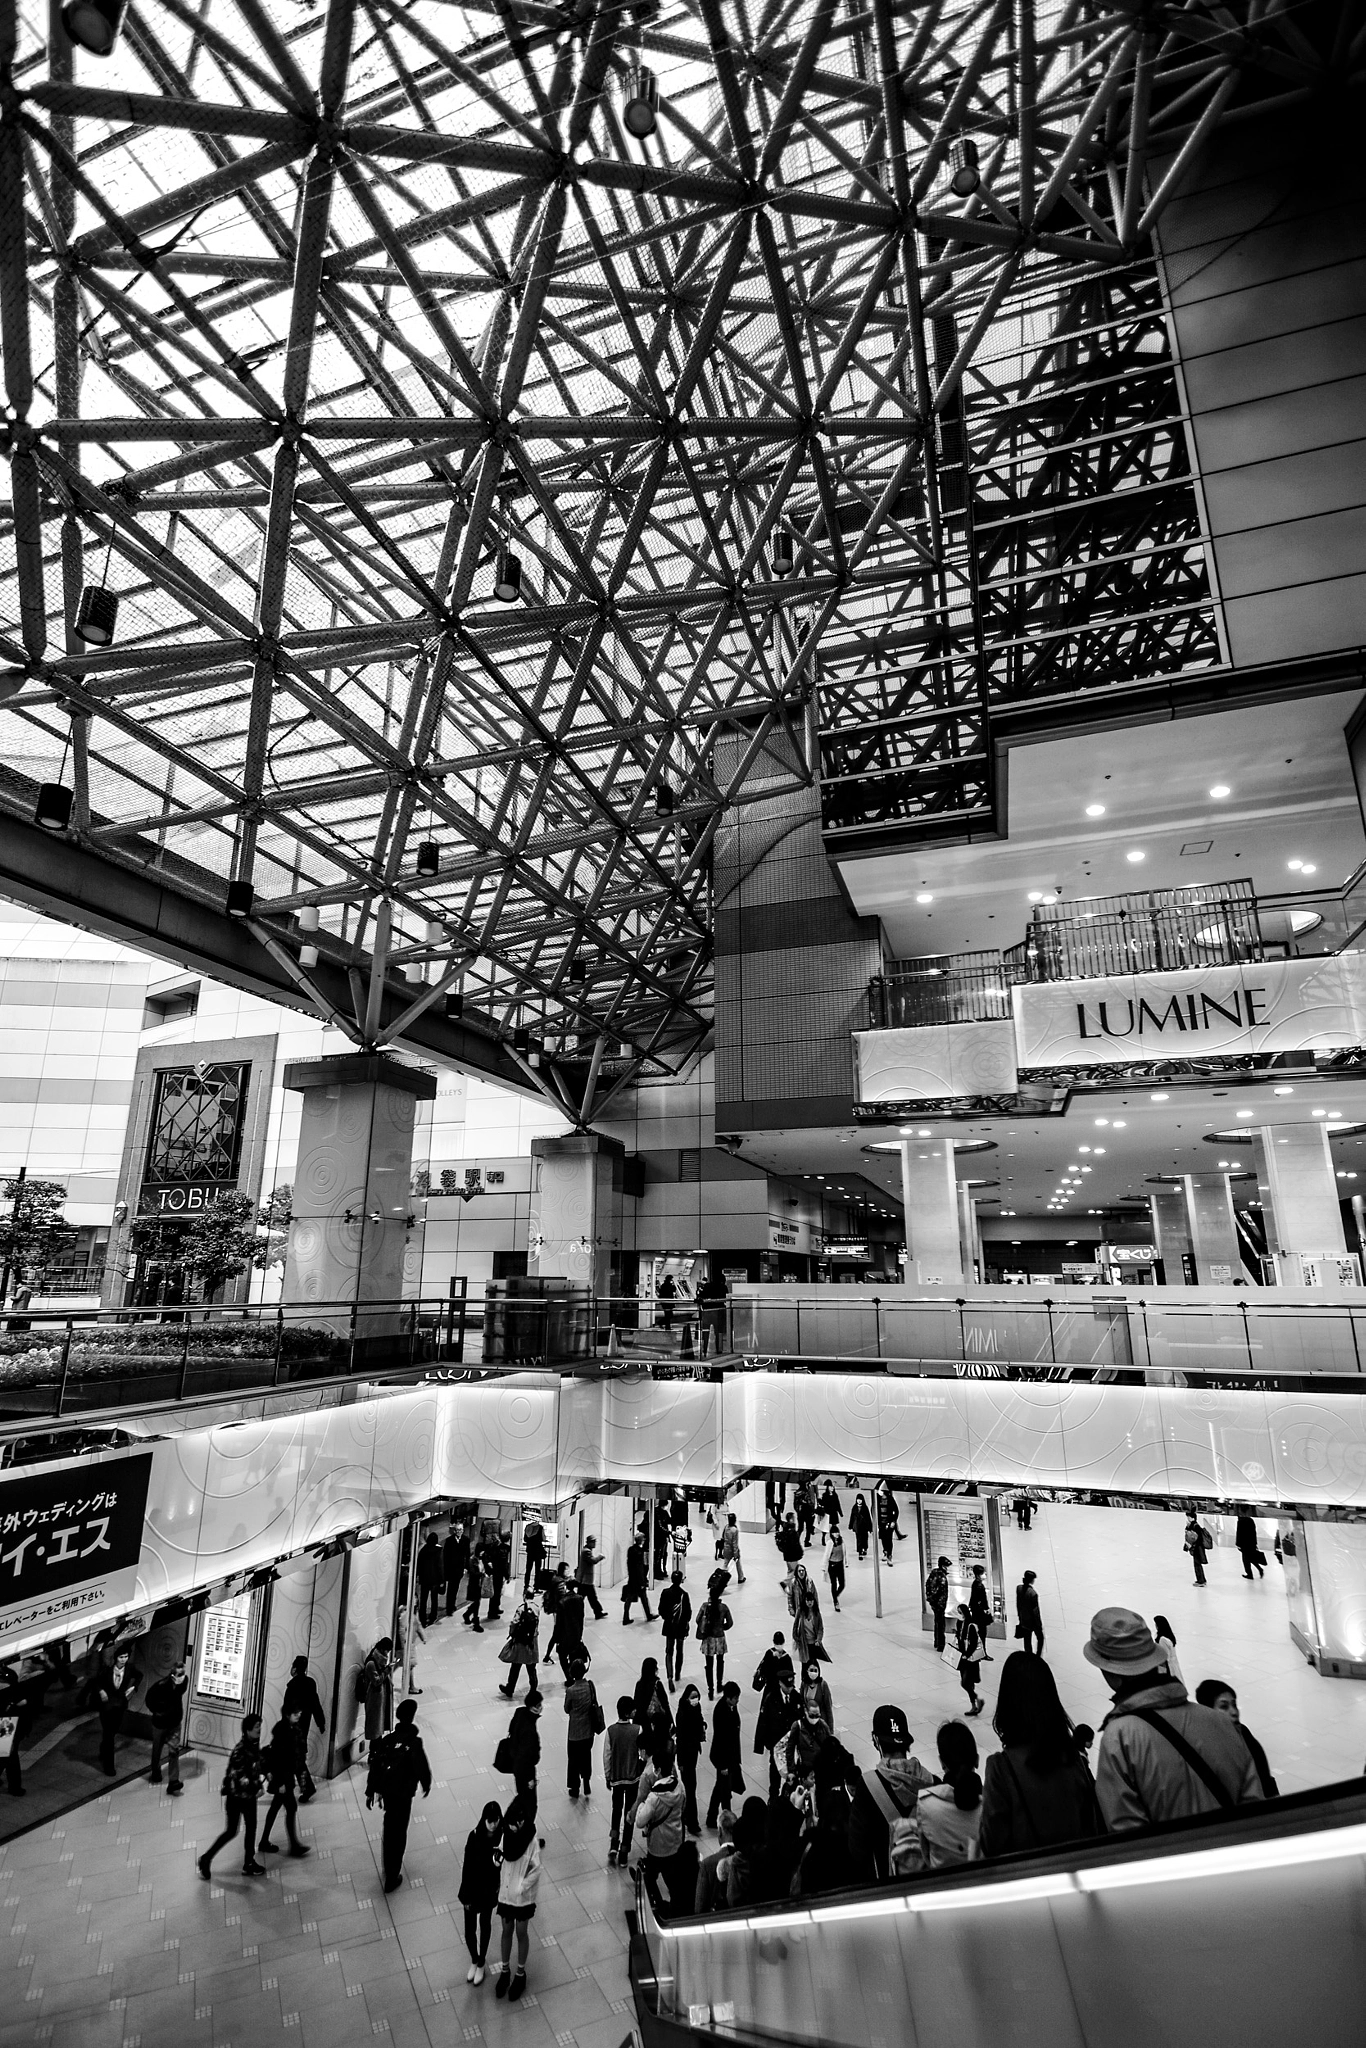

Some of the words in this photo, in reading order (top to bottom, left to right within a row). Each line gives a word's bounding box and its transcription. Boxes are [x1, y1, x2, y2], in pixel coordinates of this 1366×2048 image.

[1077, 988, 1270, 1038] LUMINE
[158, 1187, 219, 1210] TOBU
[1116, 1248, 1152, 1261] 宝くじ
[0, 1492, 118, 1535] 外ウェディングは
[0, 1516, 111, 1577] イ・エス
[890, 1718, 900, 1732] LA
